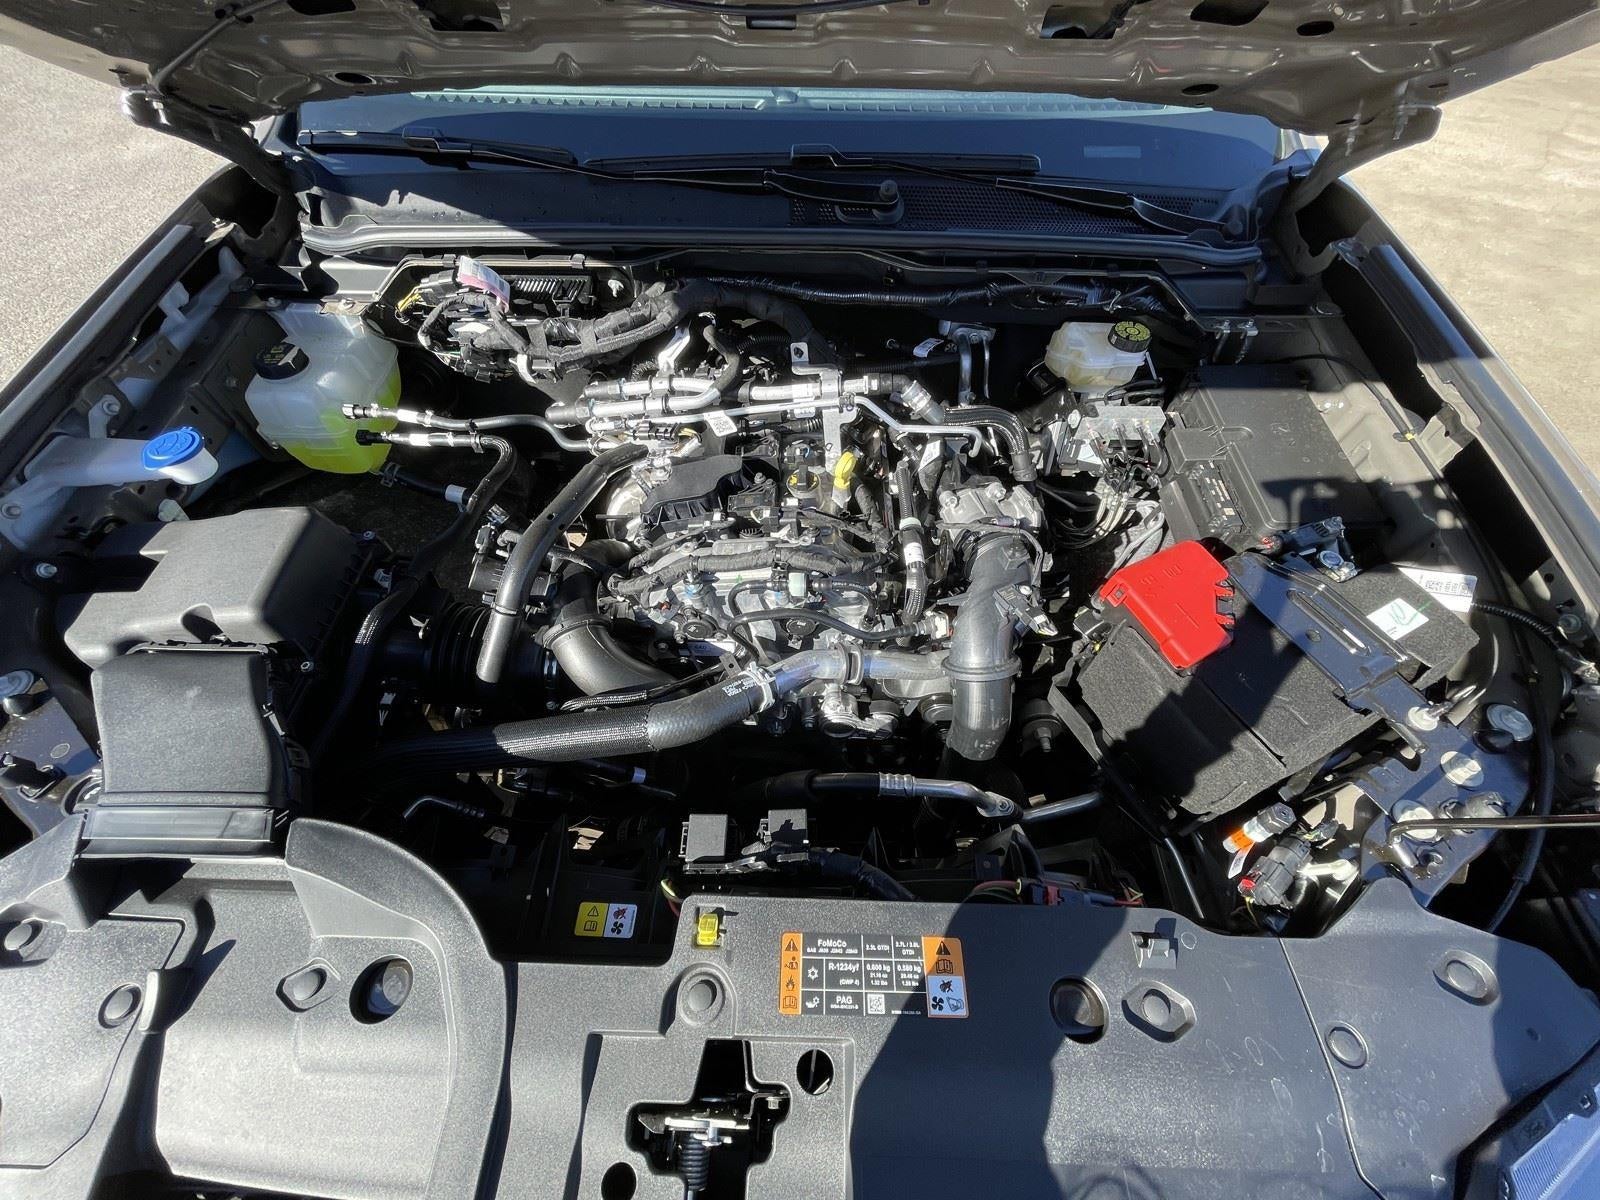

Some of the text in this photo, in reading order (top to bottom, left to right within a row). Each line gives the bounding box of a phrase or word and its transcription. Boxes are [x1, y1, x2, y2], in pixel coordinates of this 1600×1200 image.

[817, 938, 847, 948] FoMoCo
[828, 962, 860, 973] R-1234yf
[883, 964, 891, 973] kg
[913, 965, 921, 974] kg
[836, 994, 853, 1004] PAG
